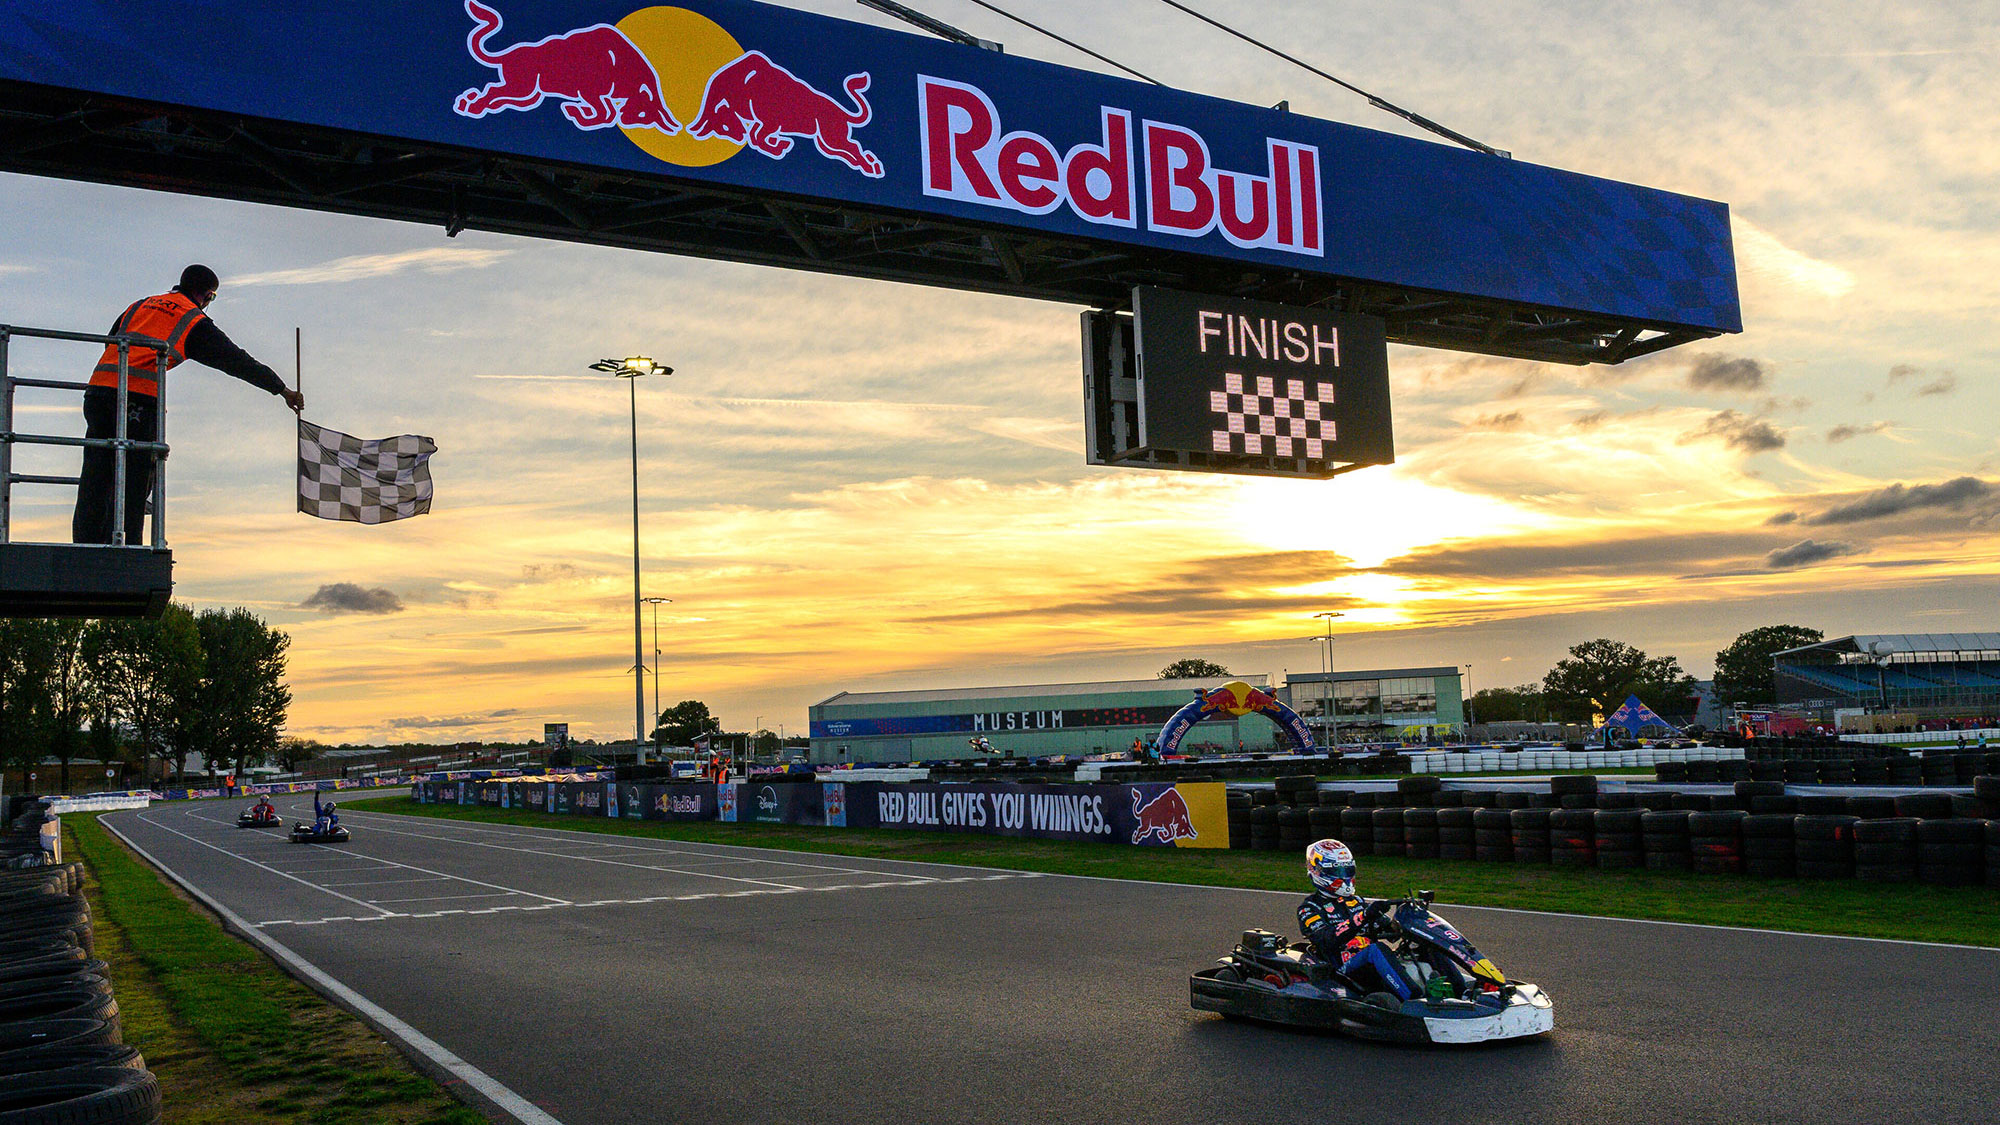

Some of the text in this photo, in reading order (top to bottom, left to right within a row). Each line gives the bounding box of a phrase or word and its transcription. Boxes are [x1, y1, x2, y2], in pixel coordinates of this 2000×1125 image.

[917, 74, 1324, 258] Red Bull
[1199, 310, 1340, 367] FINISH
[974, 710, 1063, 732] MUSEUM
[673, 795, 701, 812] Red Bull
[878, 792, 1112, 834] RED BULL GIVES YOU WIIINGS.
